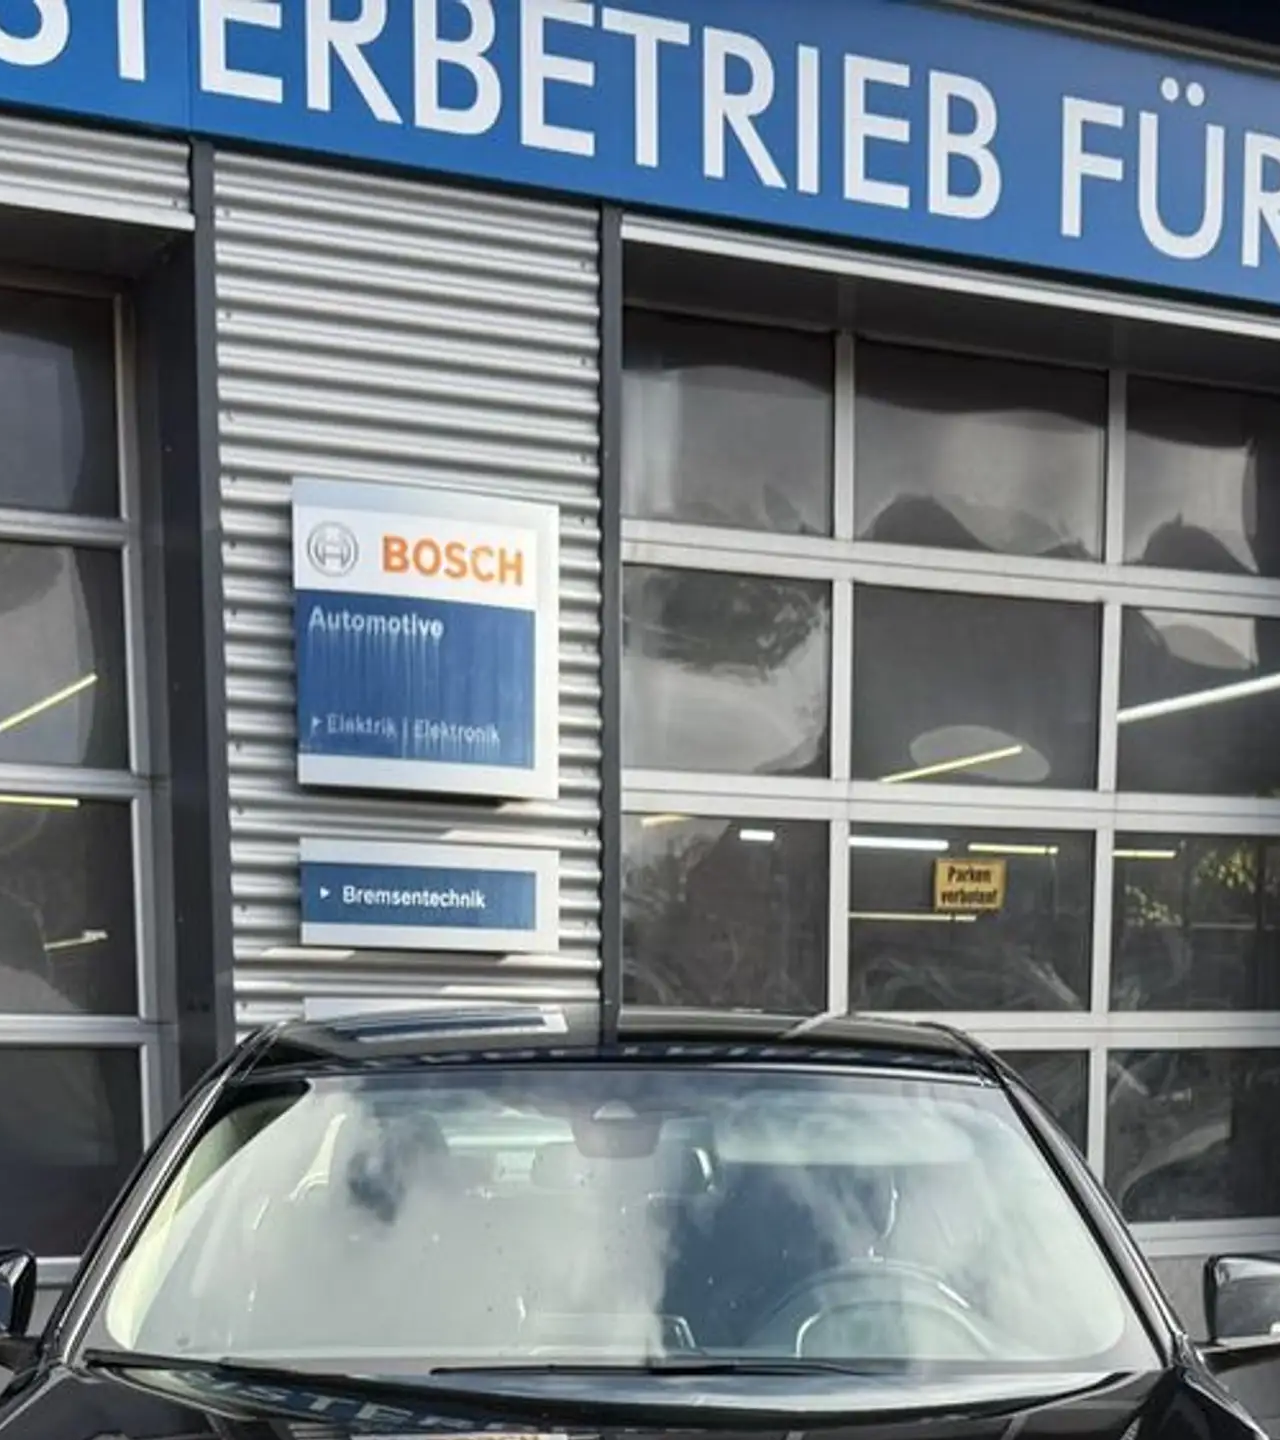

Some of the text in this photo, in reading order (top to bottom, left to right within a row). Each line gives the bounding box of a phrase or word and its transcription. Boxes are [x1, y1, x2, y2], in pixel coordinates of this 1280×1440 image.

[382, 535, 524, 586] BOSCH
[308, 605, 445, 638] Automotive
[326, 713, 501, 745] Elektrik Elektronik
[342, 885, 487, 910] Bremsentechnik
